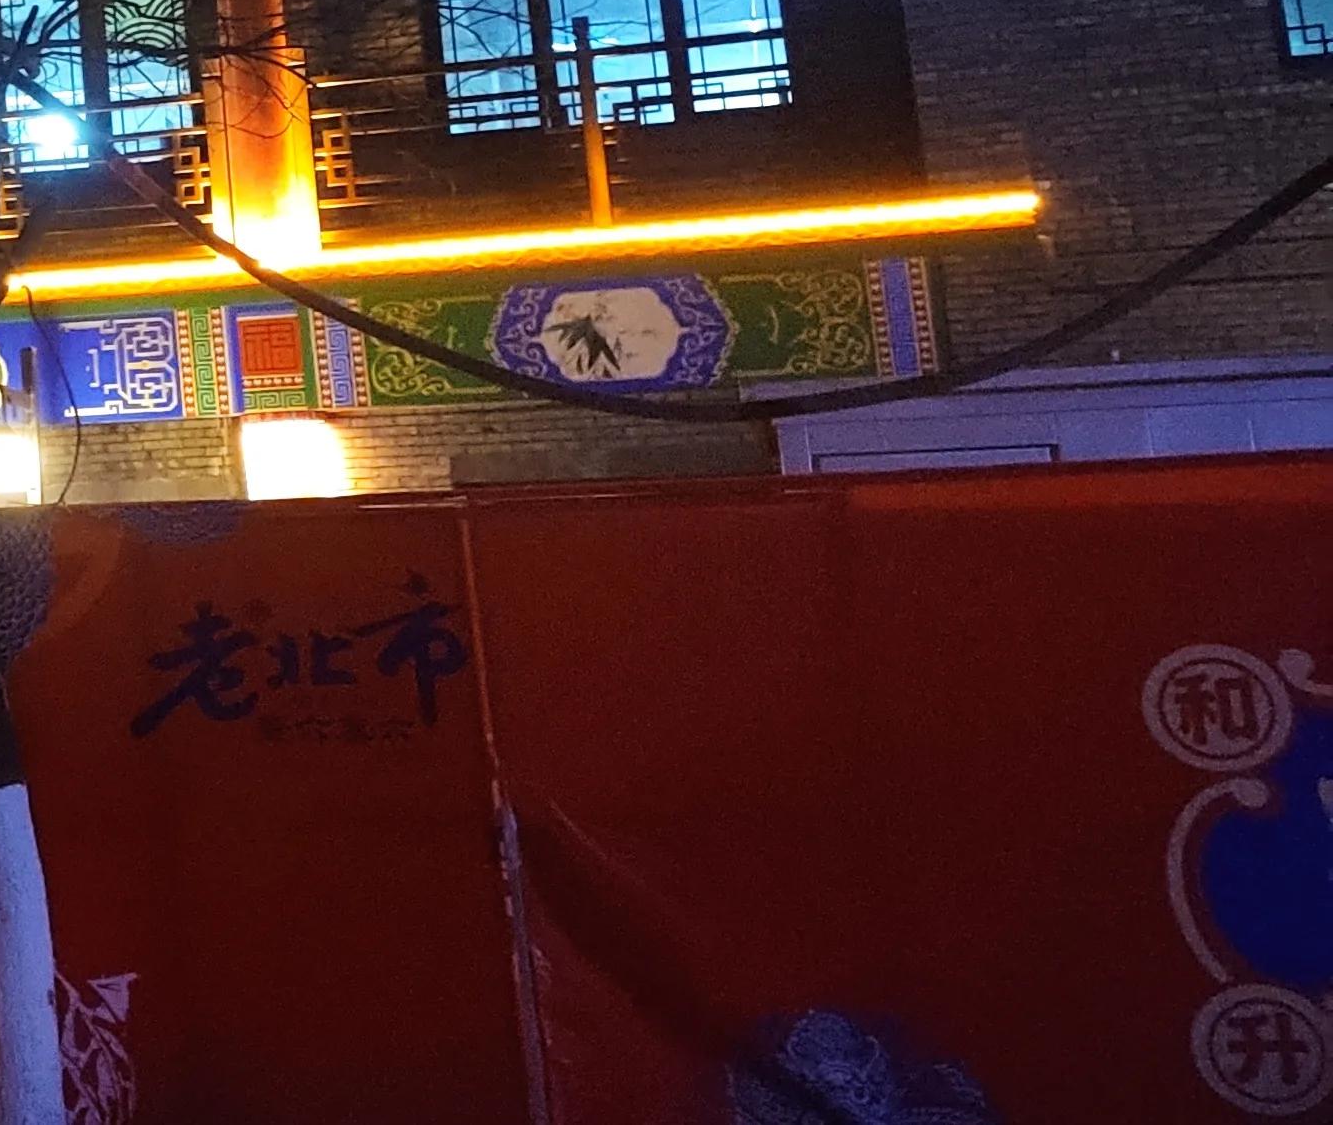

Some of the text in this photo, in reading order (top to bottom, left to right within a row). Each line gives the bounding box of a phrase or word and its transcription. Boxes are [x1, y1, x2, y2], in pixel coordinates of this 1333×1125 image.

[131, 572, 471, 737] 老北市
[1173, 674, 1260, 745] 和
[1227, 1012, 1311, 1086] 升
